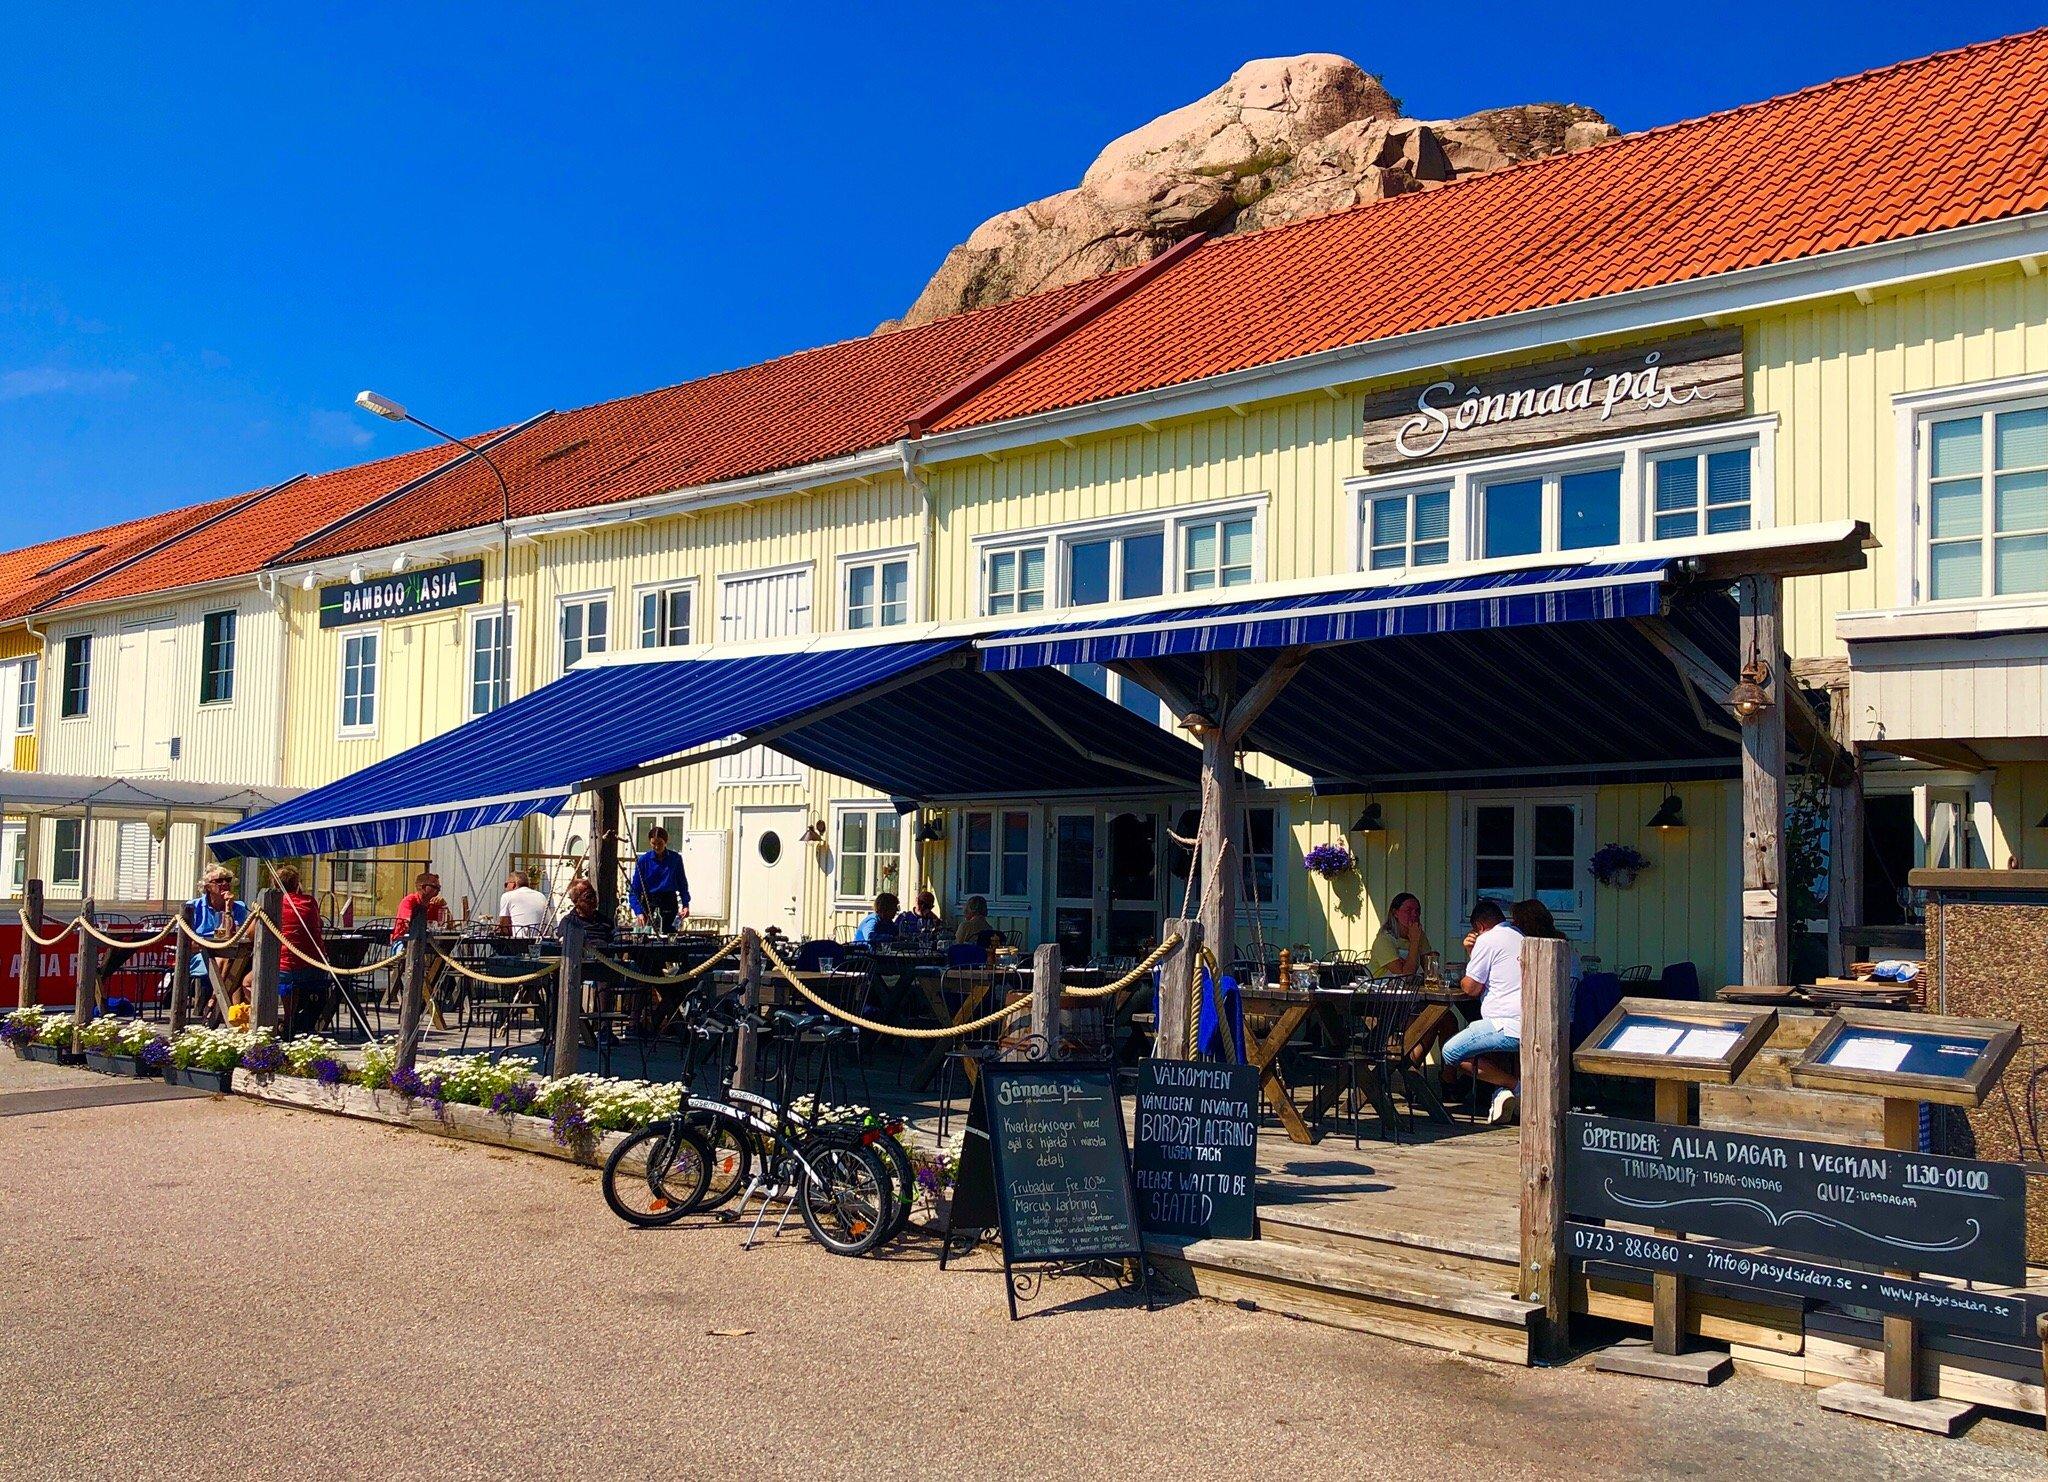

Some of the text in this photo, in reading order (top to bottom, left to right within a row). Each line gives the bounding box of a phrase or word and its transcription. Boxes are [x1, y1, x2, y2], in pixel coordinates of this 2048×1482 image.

[1599, 351, 1662, 421] på
[343, 571, 458, 614] BAMBOO ASIA
[9, 953, 61, 978] AIA
[1153, 1062, 1234, 1090] VÄLKOMMEN
[1141, 1092, 1249, 1119] VÄNLIGEN INVÄNTA
[1003, 1116, 1100, 1138] Kvarterskrogen med
[1141, 1113, 1255, 1147] BORDSPLACERING
[1026, 1138, 1034, 1150] &
[1040, 1136, 1068, 1153] hjärta
[1073, 1137, 1077, 1147] i
[1081, 1135, 1107, 1148] minsta
[1160, 1145, 1222, 1162] TUSEN TACK
[1582, 1122, 1661, 1154] ÖPPETIDER:
[1670, 1137, 1718, 1162] ALLA
[1727, 1142, 1788, 1169] DAGAR
[1799, 1152, 1804, 1169] I
[1905, 1163, 1990, 1192] 11.30-01.00
[1036, 1153, 1068, 1168] detalj.
[1009, 1179, 1055, 1195] Trubadur
[1065, 1176, 1079, 1197] fre
[1136, 1170, 1247, 1196] PLEASE WAIT TO BE
[1621, 1158, 1783, 1193] TRUBADUR: TISDAG-ONSDAG
[1150, 1192, 1213, 1226] SEATED
[1575, 1230, 1679, 1263] 0723-886860
[1706, 1249, 1853, 1290] info@pasydsidan.se
